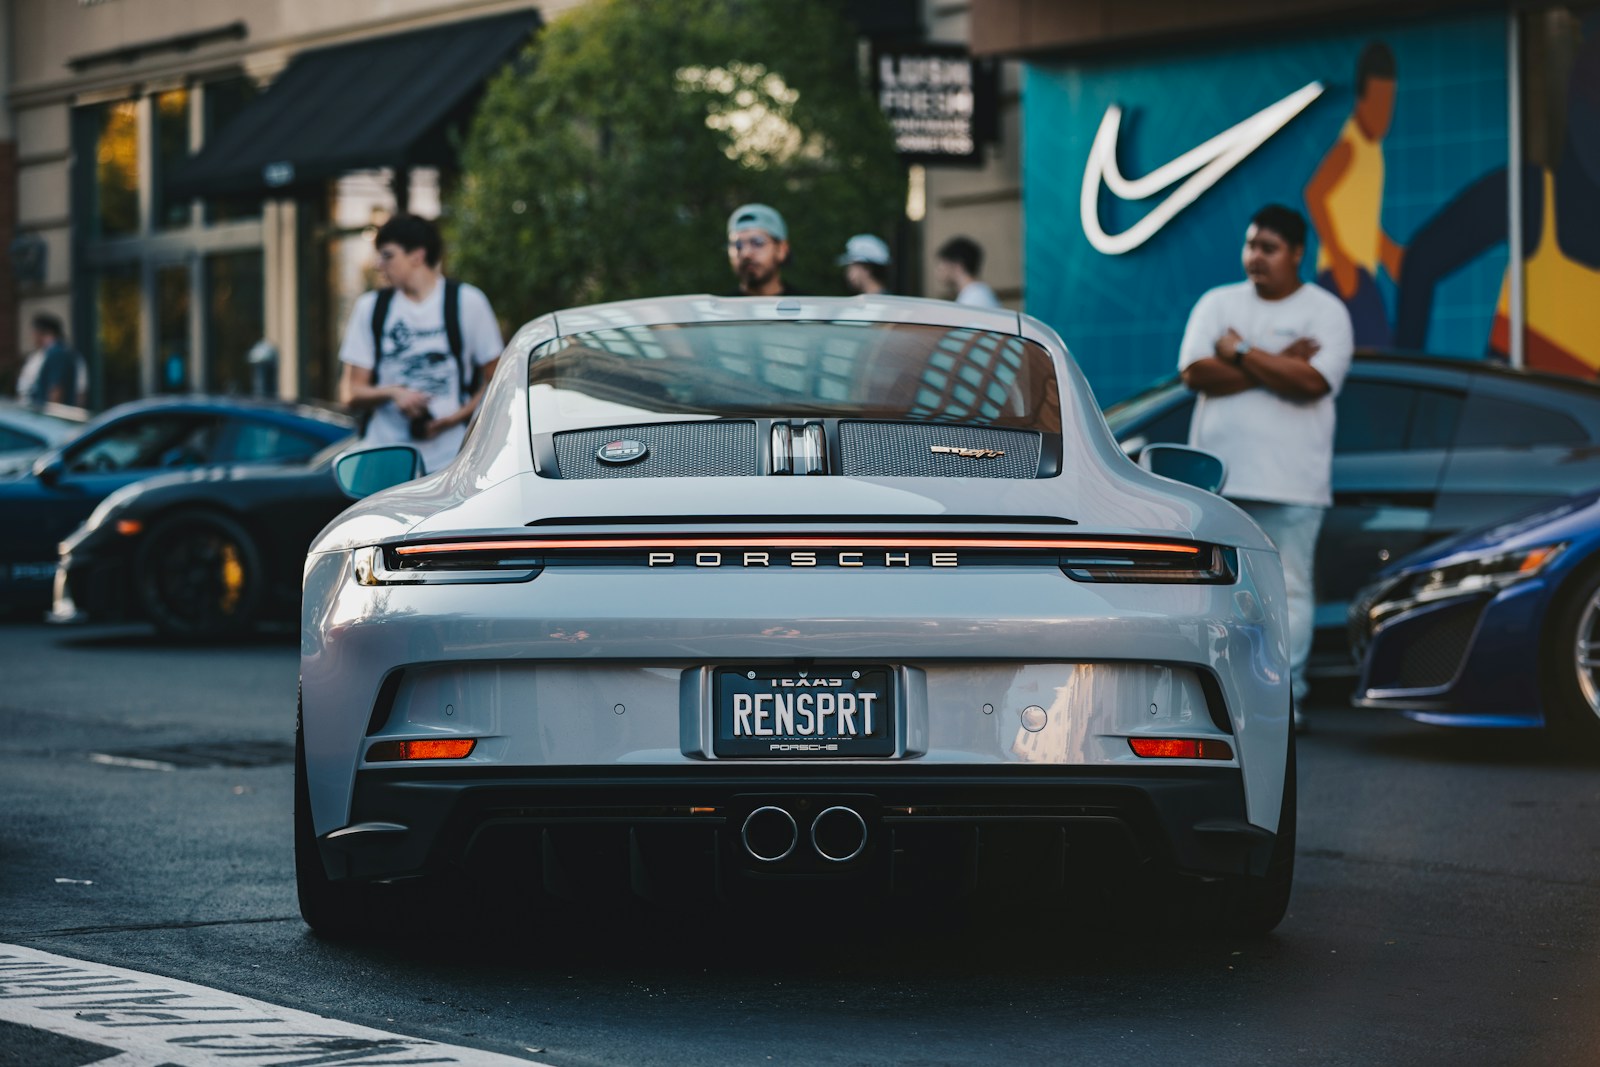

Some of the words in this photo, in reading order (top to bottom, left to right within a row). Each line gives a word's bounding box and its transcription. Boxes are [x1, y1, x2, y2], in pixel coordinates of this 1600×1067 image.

[649, 552, 958, 567] PORSCHE
[771, 678, 842, 687] TEXAS
[733, 692, 878, 736] RENSPRT
[769, 743, 838, 751] PORSCHE
